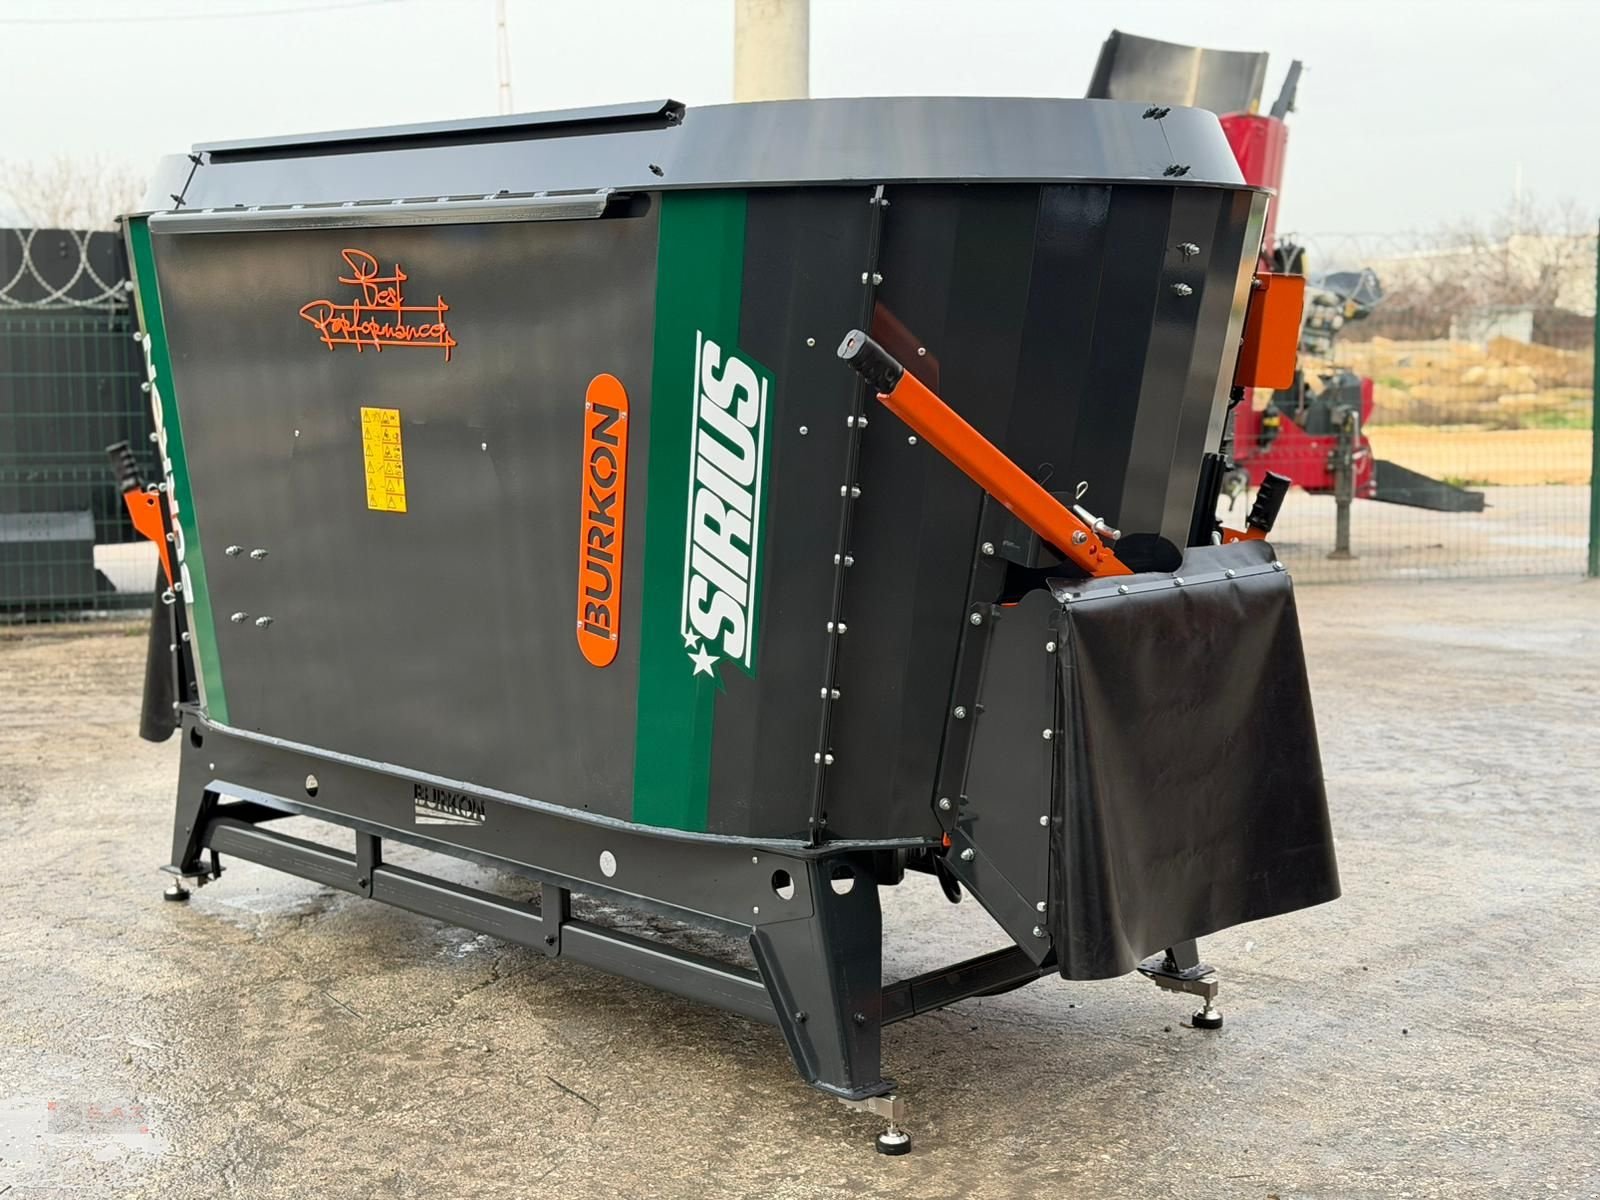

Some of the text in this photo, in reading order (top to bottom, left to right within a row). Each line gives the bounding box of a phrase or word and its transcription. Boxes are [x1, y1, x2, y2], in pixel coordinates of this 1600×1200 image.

[338, 248, 408, 308] Best
[583, 403, 620, 640] BURKON
[688, 340, 760, 660] SIRIUS
[414, 783, 486, 822] BURKON
